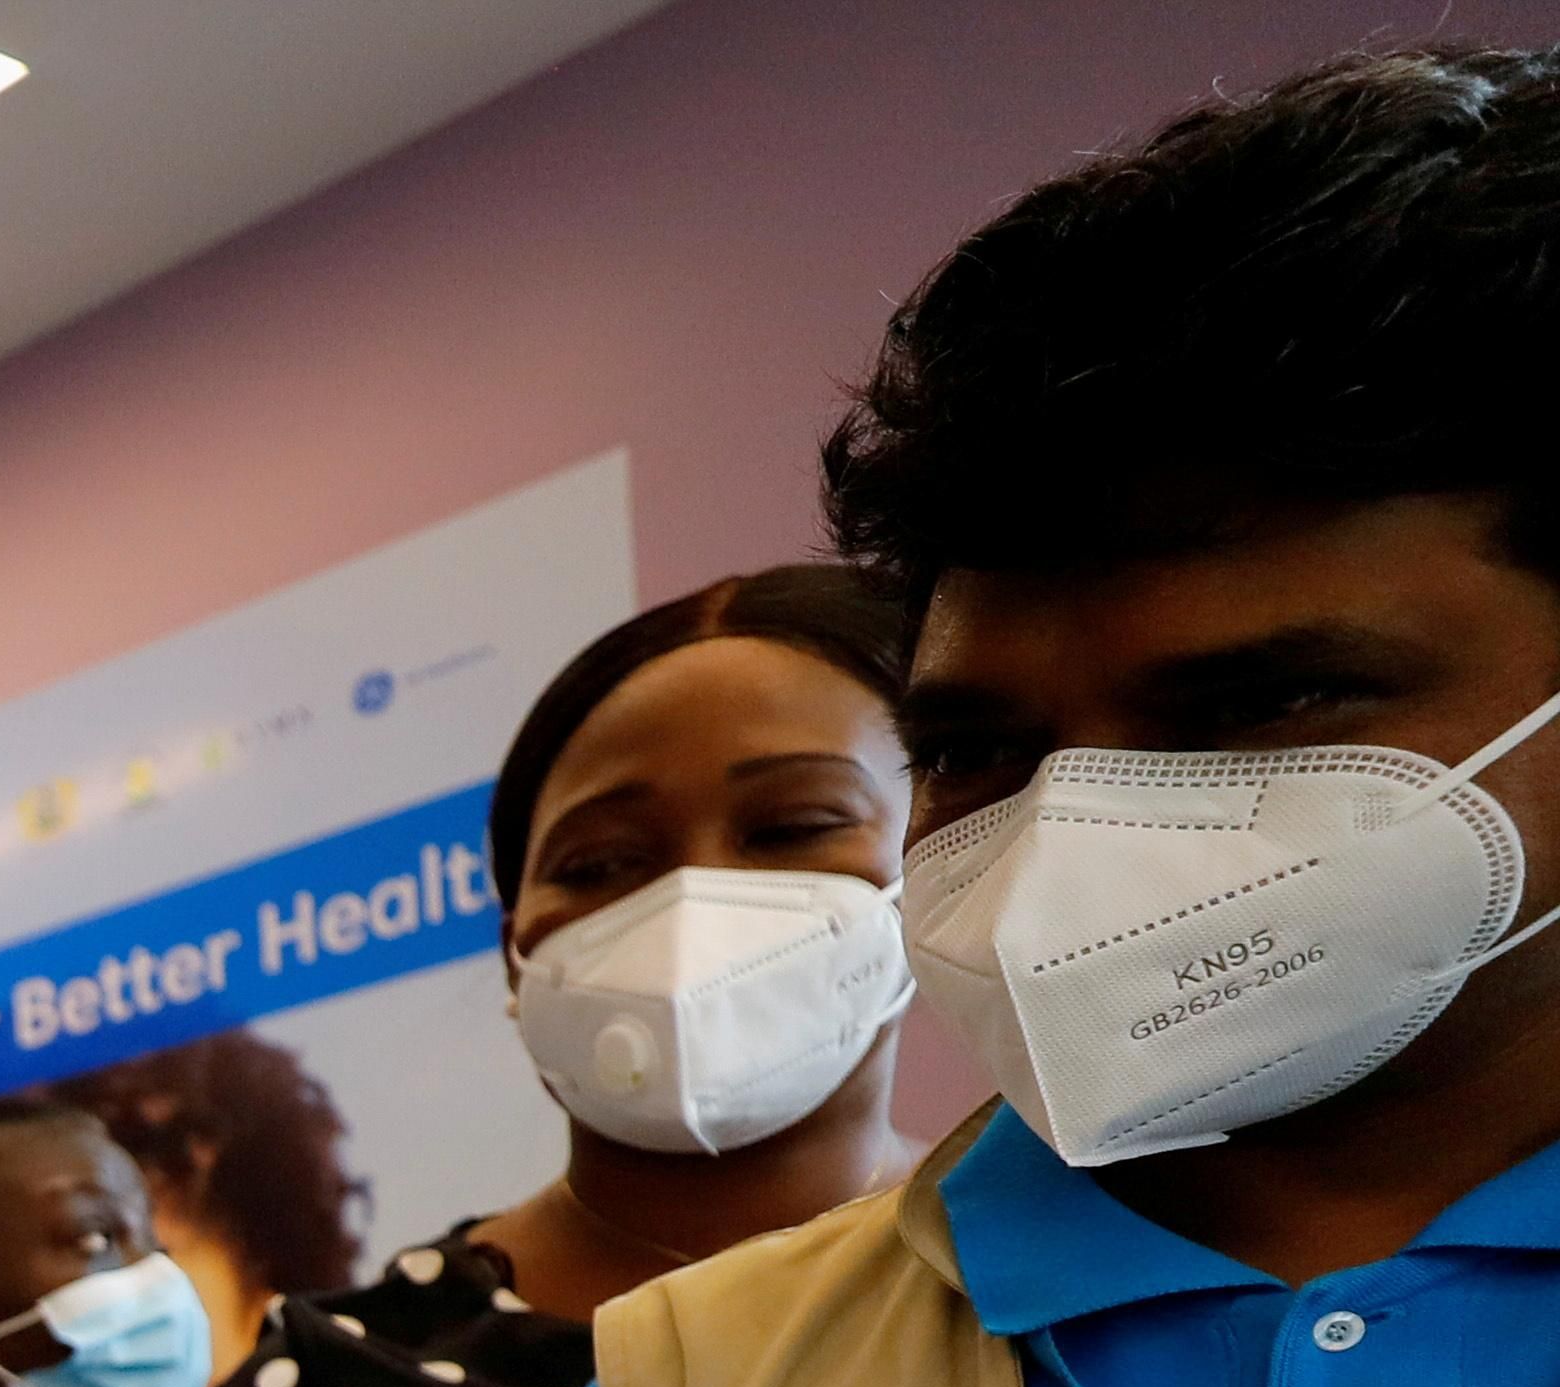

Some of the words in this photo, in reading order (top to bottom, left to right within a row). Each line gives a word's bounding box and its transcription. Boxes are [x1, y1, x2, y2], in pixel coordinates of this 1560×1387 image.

[12, 929, 241, 1050] Better
[258, 842, 501, 975] Healt
[1130, 943, 1324, 1040] GB2626-2006
[1173, 928, 1274, 990] KN95
